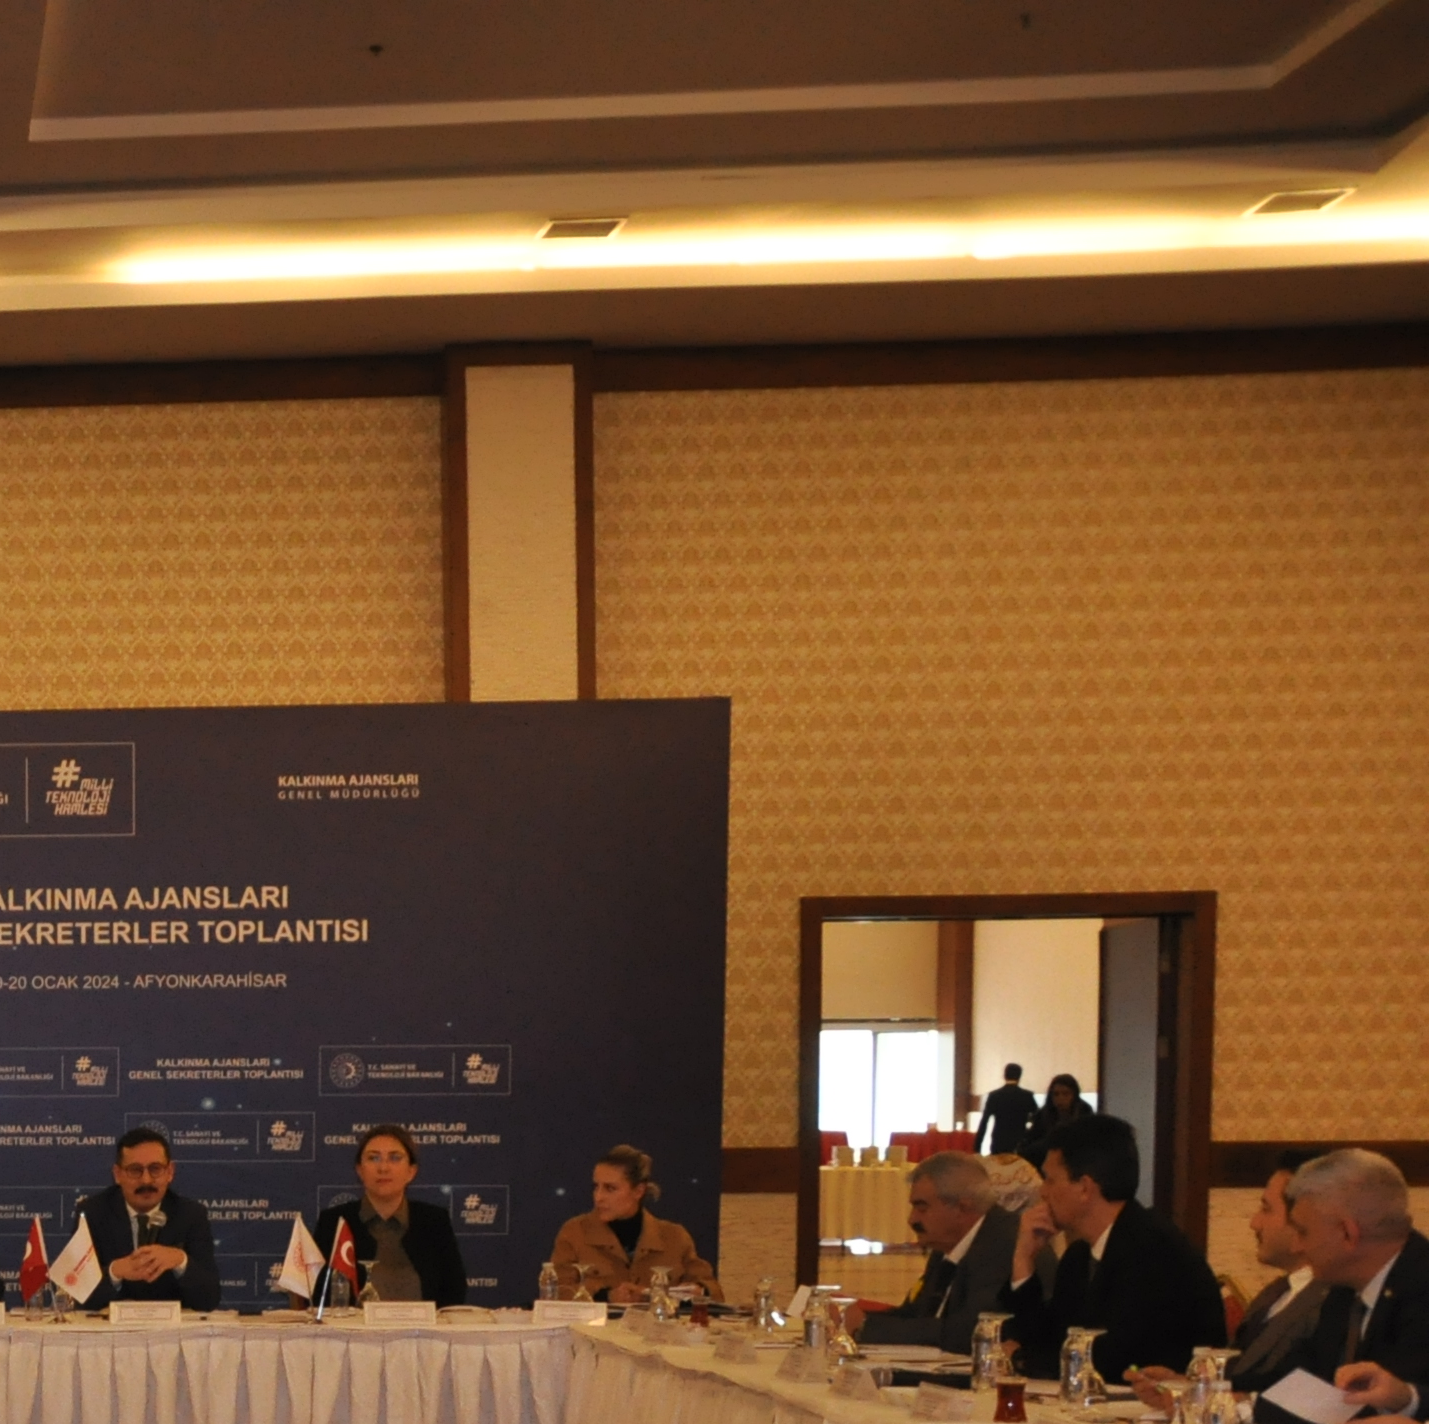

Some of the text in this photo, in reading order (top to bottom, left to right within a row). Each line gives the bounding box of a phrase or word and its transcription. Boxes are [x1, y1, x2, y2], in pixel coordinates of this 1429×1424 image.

[278, 773, 420, 787] KALKINMA AJANSLARI
[277, 787, 421, 800] GENEL MÜDÜRLÜĞÜ
[122, 885, 290, 911] AJANSLARI
[195, 918, 371, 943] TOPLANTISI
[31, 974, 81, 991] OCAK
[82, 974, 121, 991] 2024
[133, 970, 289, 990] AFYONKARAHİSAR
[156, 1057, 271, 1068] KALKINMA AJANSLARI
[128, 1069, 305, 1080] GENEL SEKRETERLER TOPLANTISI
[24, 1124, 83, 1133] AJANSLARI
[407, 1122, 467, 1132] AJANSLARI
[55, 1136, 117, 1145] TOPLANTISI
[324, 1135, 359, 1145] GENEL
[440, 1134, 501, 1144] TOPLANTISI
[210, 1199, 269, 1208] AJANSLARI
